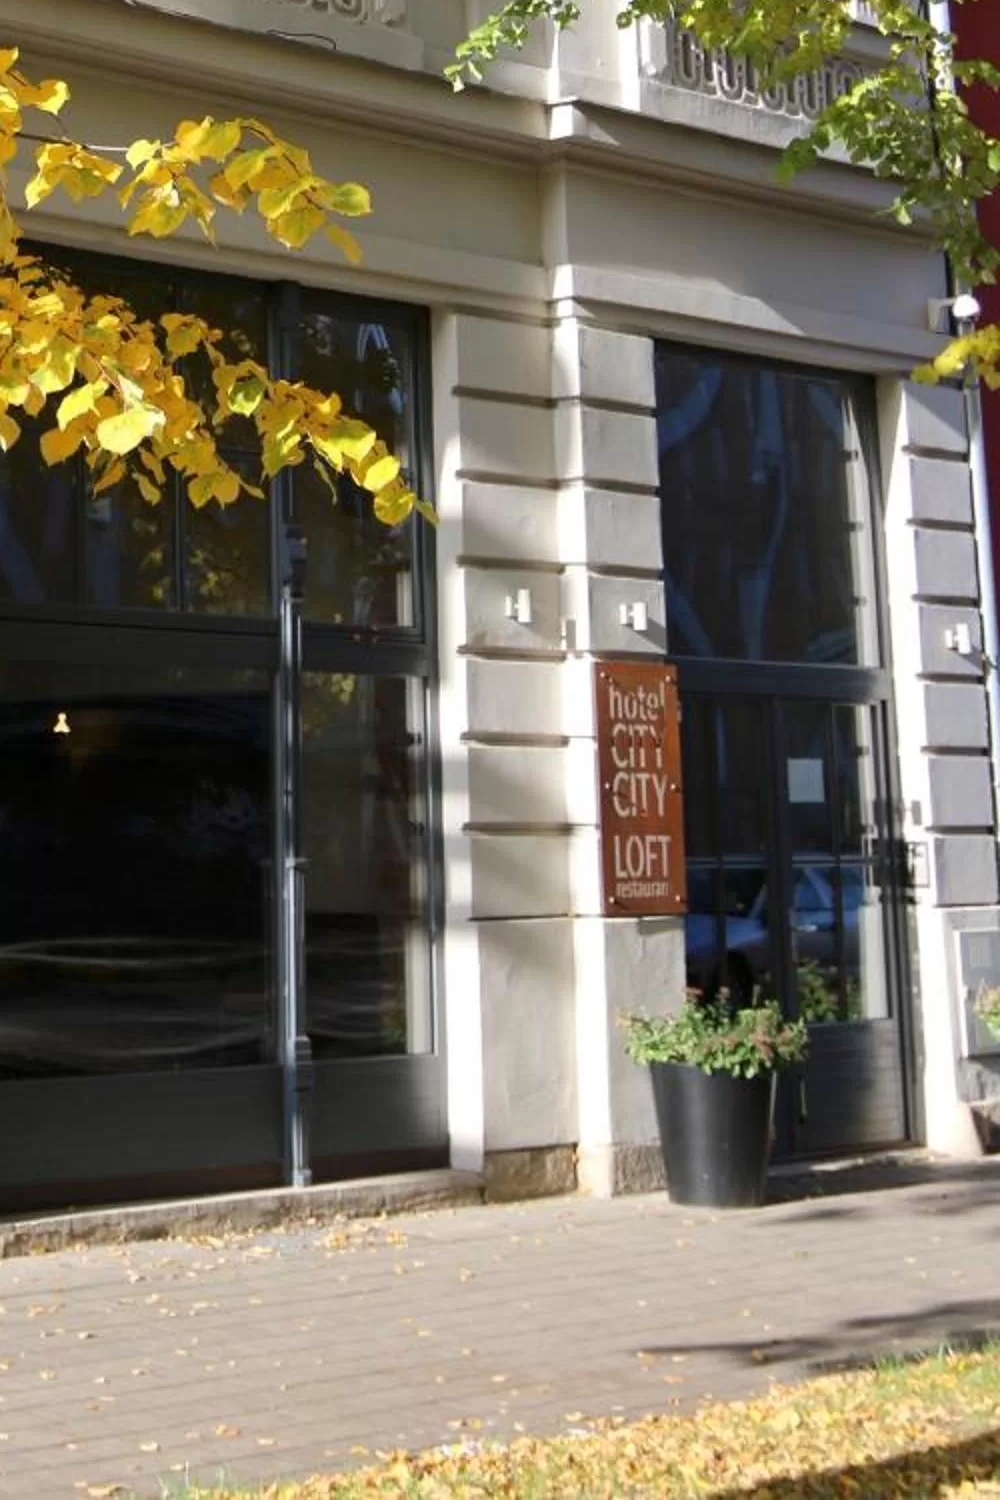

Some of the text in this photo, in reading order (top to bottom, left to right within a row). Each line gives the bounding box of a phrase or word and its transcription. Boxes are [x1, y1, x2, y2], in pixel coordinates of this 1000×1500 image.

[609, 679, 666, 720] hotel
[611, 724, 664, 768] CITY
[612, 772, 669, 817] CITY
[614, 835, 671, 878] LOFT
[616, 880, 670, 898] restauran
